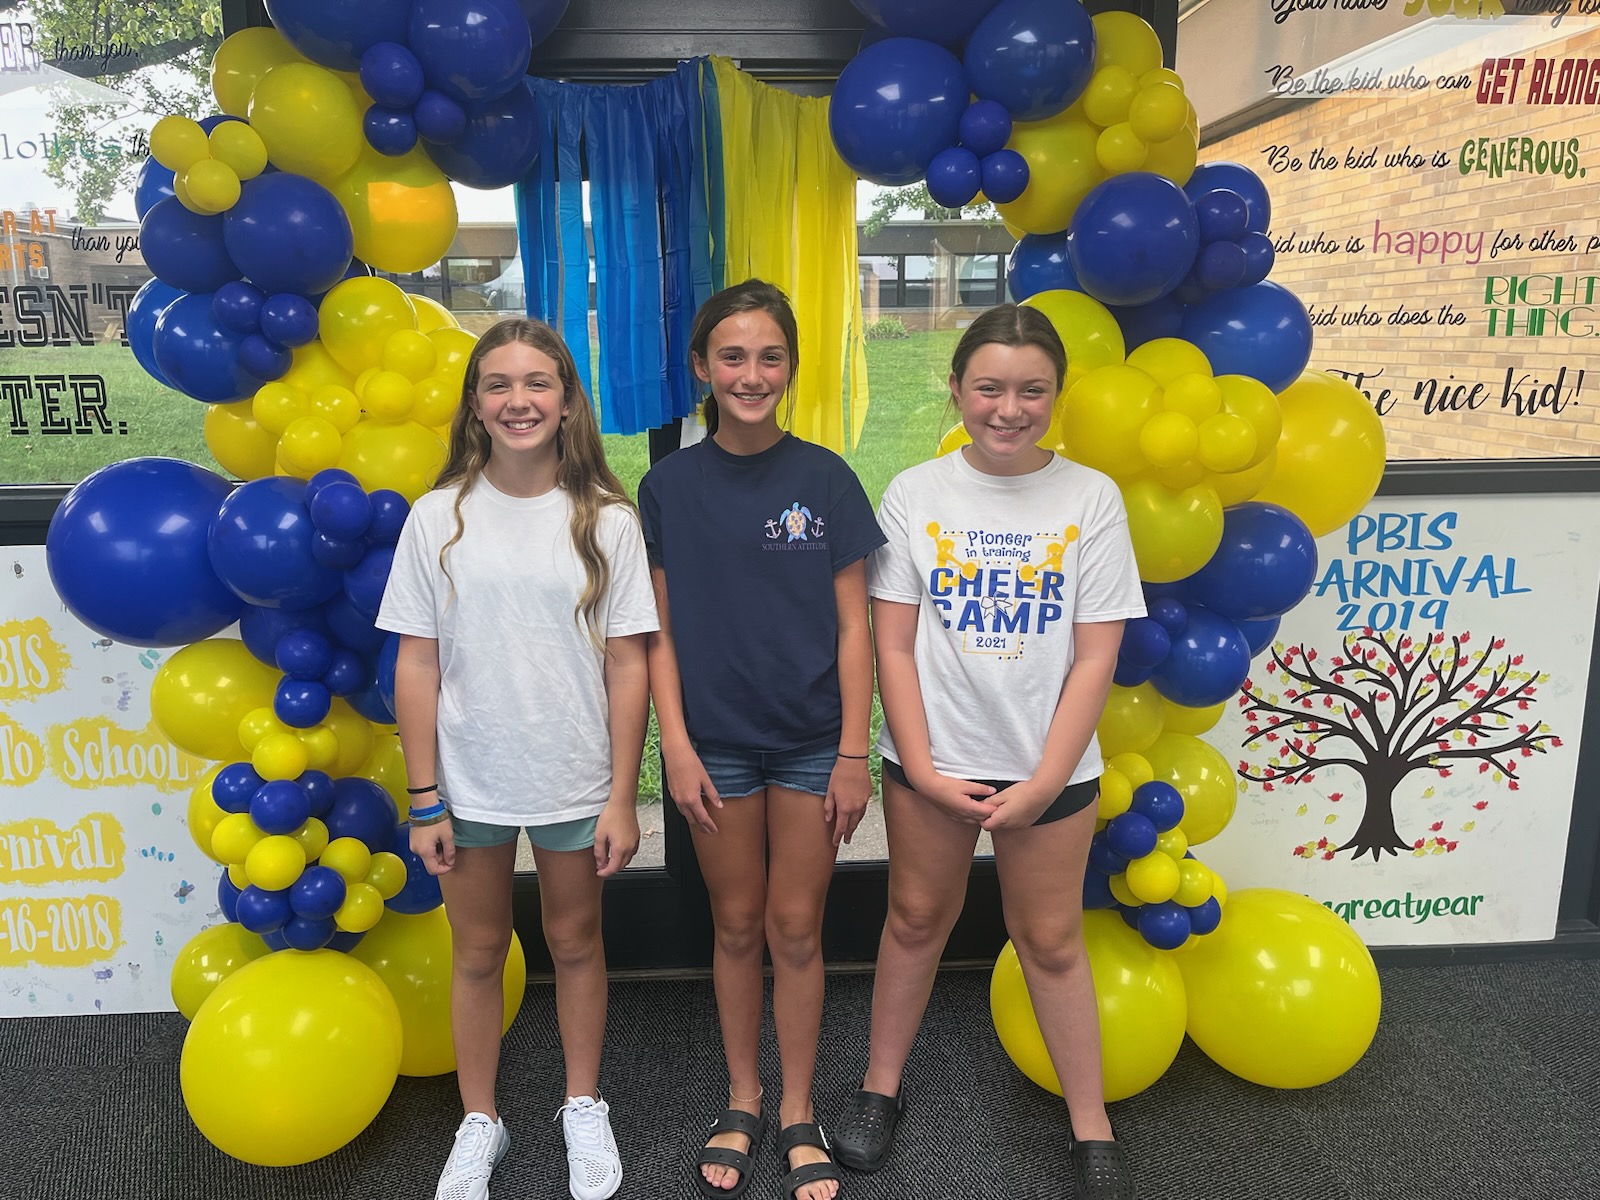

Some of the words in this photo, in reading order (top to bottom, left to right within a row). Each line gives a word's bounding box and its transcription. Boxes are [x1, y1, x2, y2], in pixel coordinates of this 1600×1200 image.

[54, 35, 94, 61] than
[1264, 64, 1307, 95] Be
[1312, 67, 1343, 94] the
[1349, 66, 1382, 91] kid
[1388, 65, 1430, 90] who
[1435, 74, 1472, 90] can
[1476, 58, 1526, 105] GET
[1526, 58, 1600, 105] ALONG
[131, 131, 150, 157] th
[1260, 144, 1303, 173] Be
[1308, 146, 1338, 171] the
[1345, 146, 1378, 170] kid
[1384, 146, 1426, 169] who
[1431, 149, 1451, 167] is
[1458, 136, 1587, 180] GENEROUS.
[30, 208, 58, 235] AT
[71, 226, 110, 251] than
[1266, 231, 1296, 253] id
[1298, 232, 1340, 254] who
[1345, 236, 1365, 253] is
[1373, 219, 1484, 265] happy
[1490, 229, 1524, 258] for
[1528, 230, 1578, 251] other
[1484, 275, 1600, 306] RIGHT
[1341, 304, 1382, 326] who
[1388, 304, 1433, 326] does
[1437, 304, 1467, 326] the
[1413, 374, 1490, 416] nice
[761, 543, 797, 551] SOUTHERN
[966, 529, 1032, 547] Pioneer
[1346, 511, 1458, 556] PBIS
[965, 548, 977, 558] in
[982, 546, 1032, 563] training
[929, 567, 1065, 602] CHEER
[1308, 554, 1533, 604] ARNIVAL
[931, 598, 1063, 635] CAMP
[1335, 599, 1449, 632] 2019
[976, 636, 1007, 649] 2021
